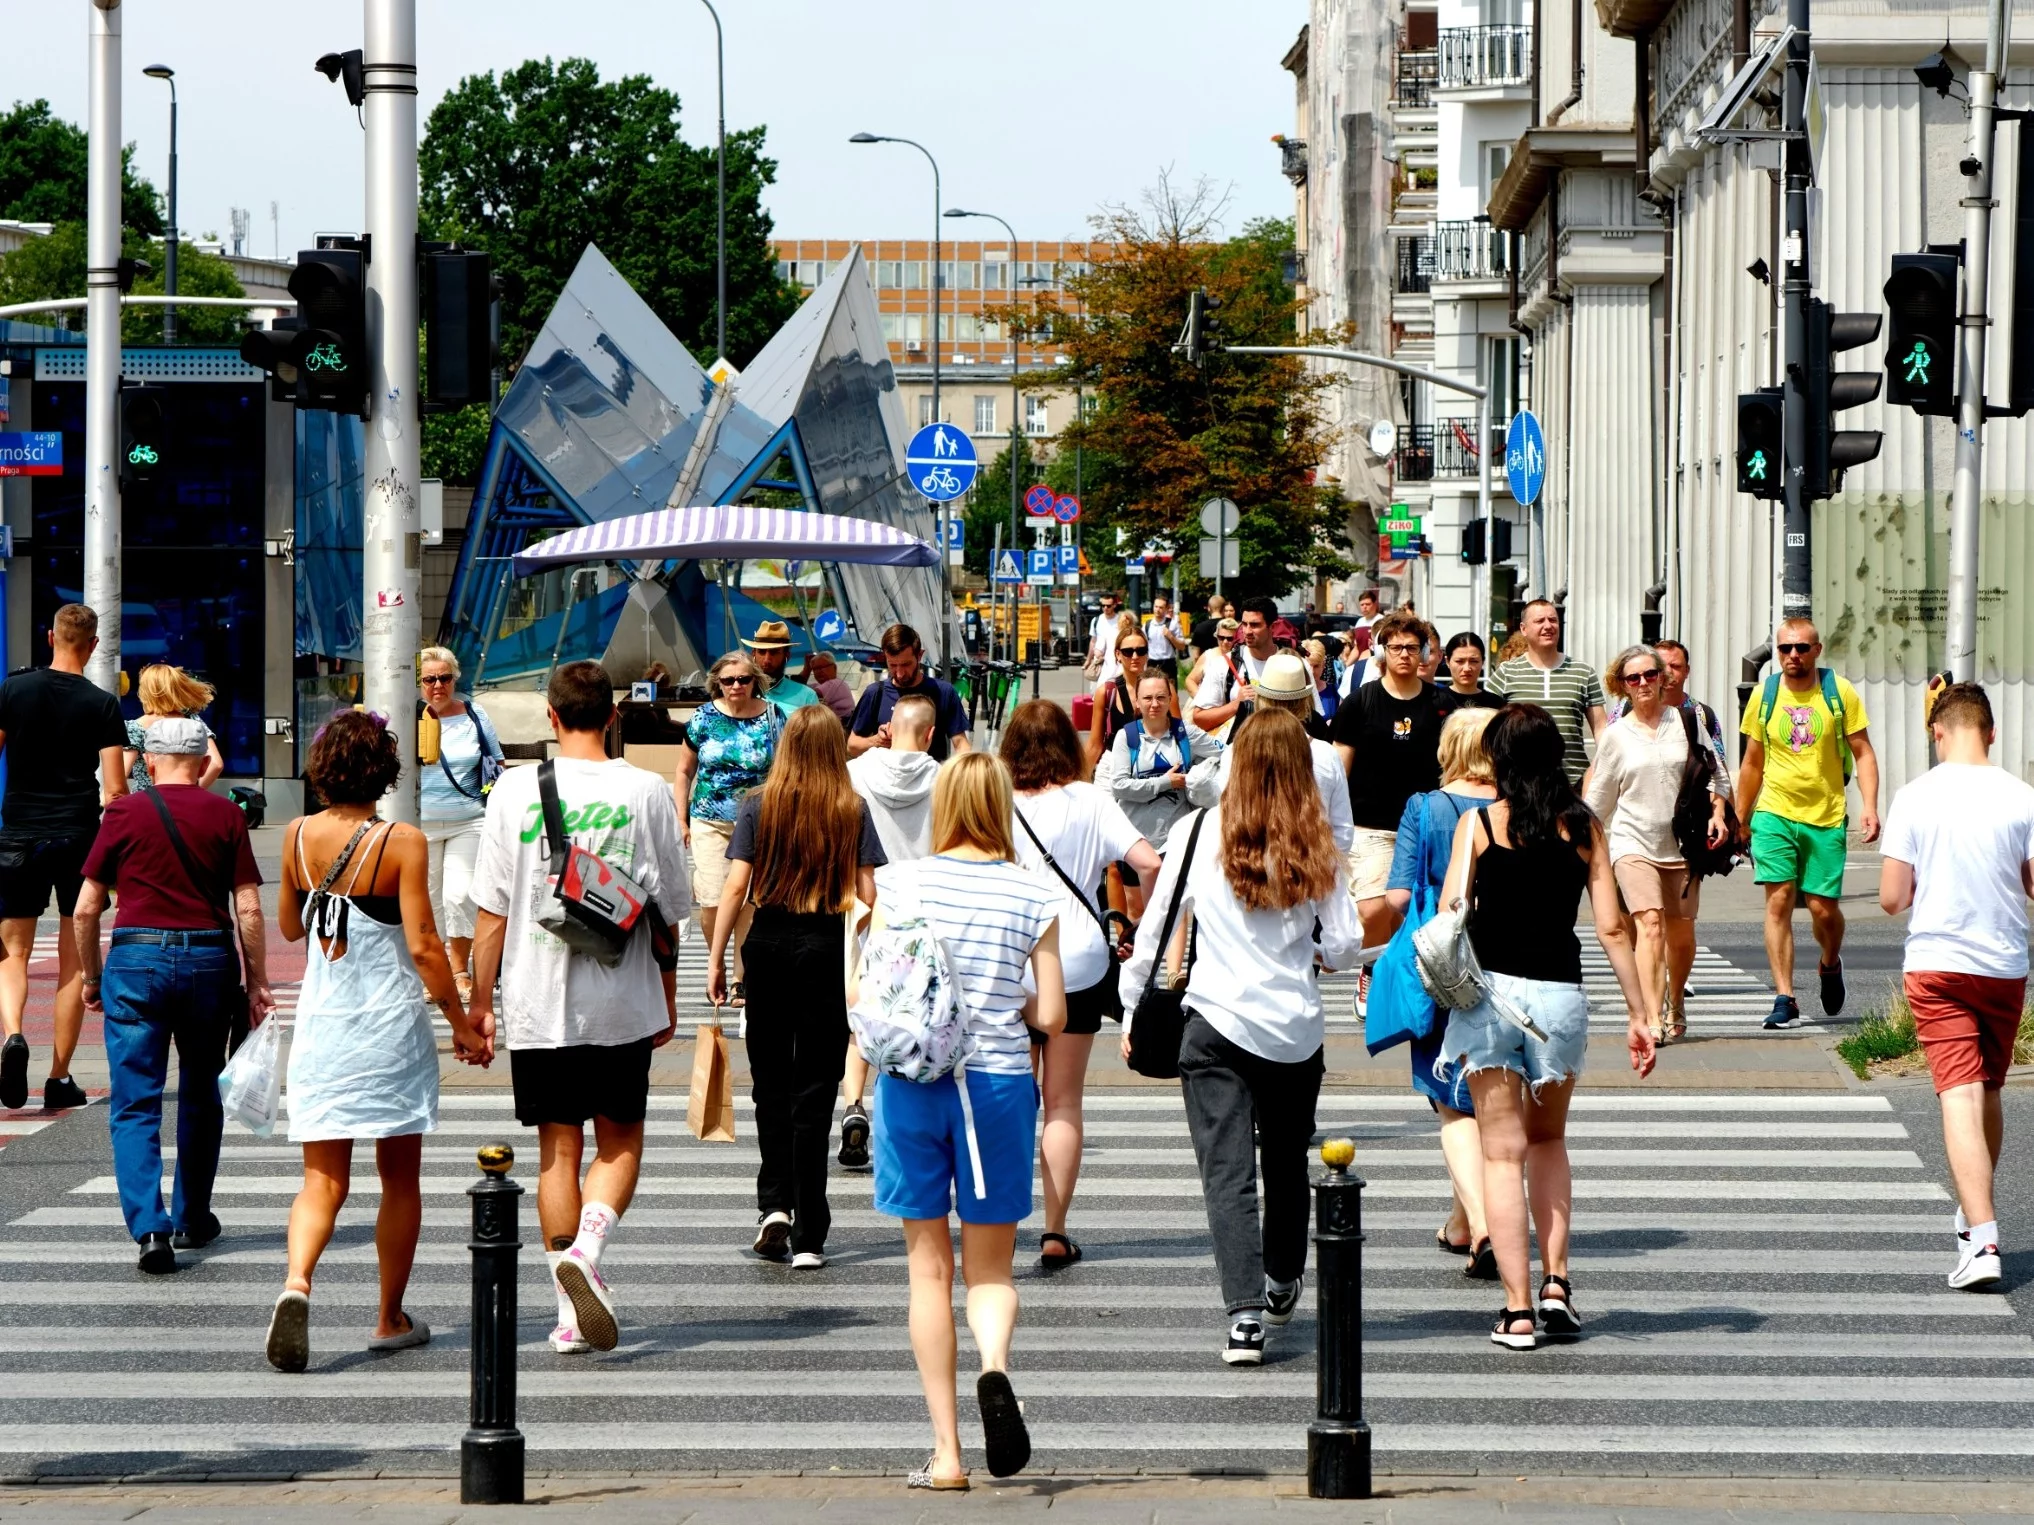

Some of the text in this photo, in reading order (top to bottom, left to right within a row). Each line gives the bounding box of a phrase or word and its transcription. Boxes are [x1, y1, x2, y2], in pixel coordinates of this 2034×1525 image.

[34, 433, 56, 442] 44-10
[1, 466, 20, 475] Praga
[1789, 535, 1803, 545] FRS
[1060, 547, 1075, 566] P
[1034, 553, 1048, 572] P
[528, 933, 554, 946] THE
